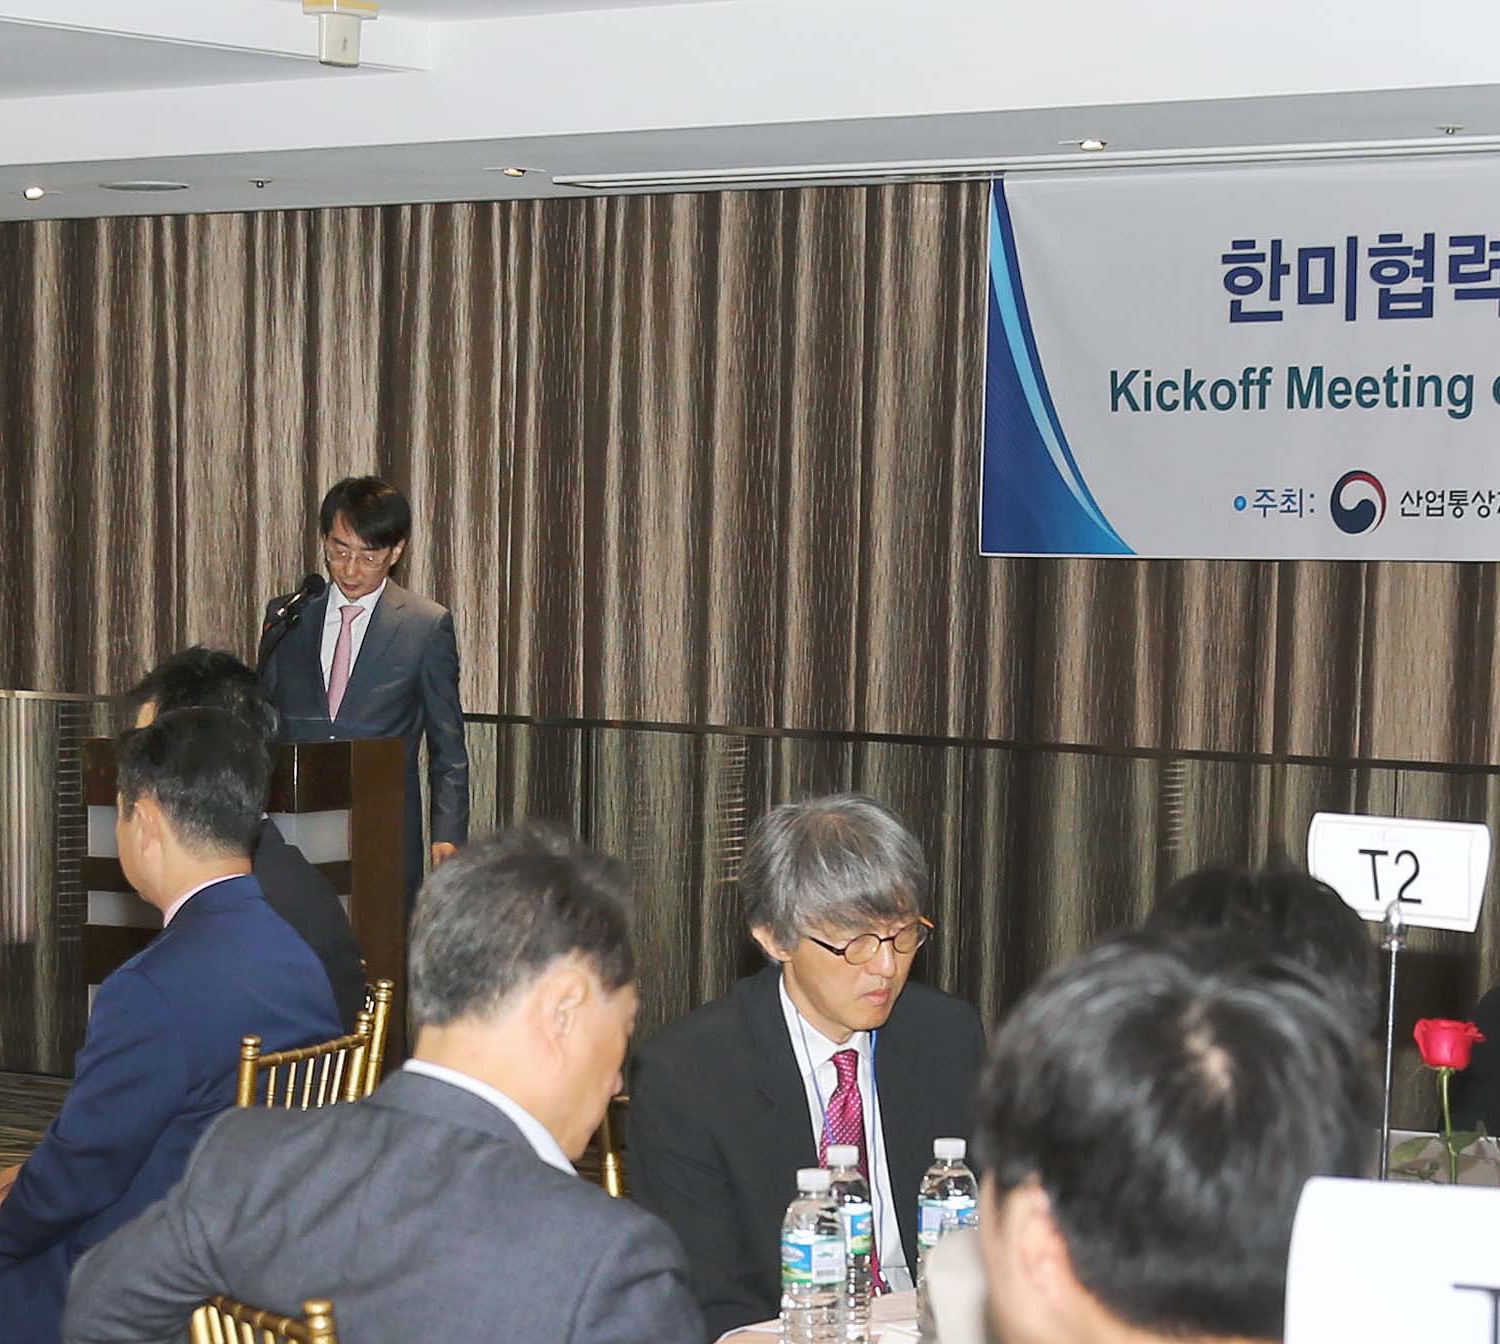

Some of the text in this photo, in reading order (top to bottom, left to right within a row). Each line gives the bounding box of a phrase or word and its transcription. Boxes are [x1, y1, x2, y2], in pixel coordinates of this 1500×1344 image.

[1109, 365, 1273, 414] Kickoff
[1286, 361, 1475, 420] Meeting
[1252, 486, 1316, 519] 주최:
[1358, 848, 1422, 905] T2
